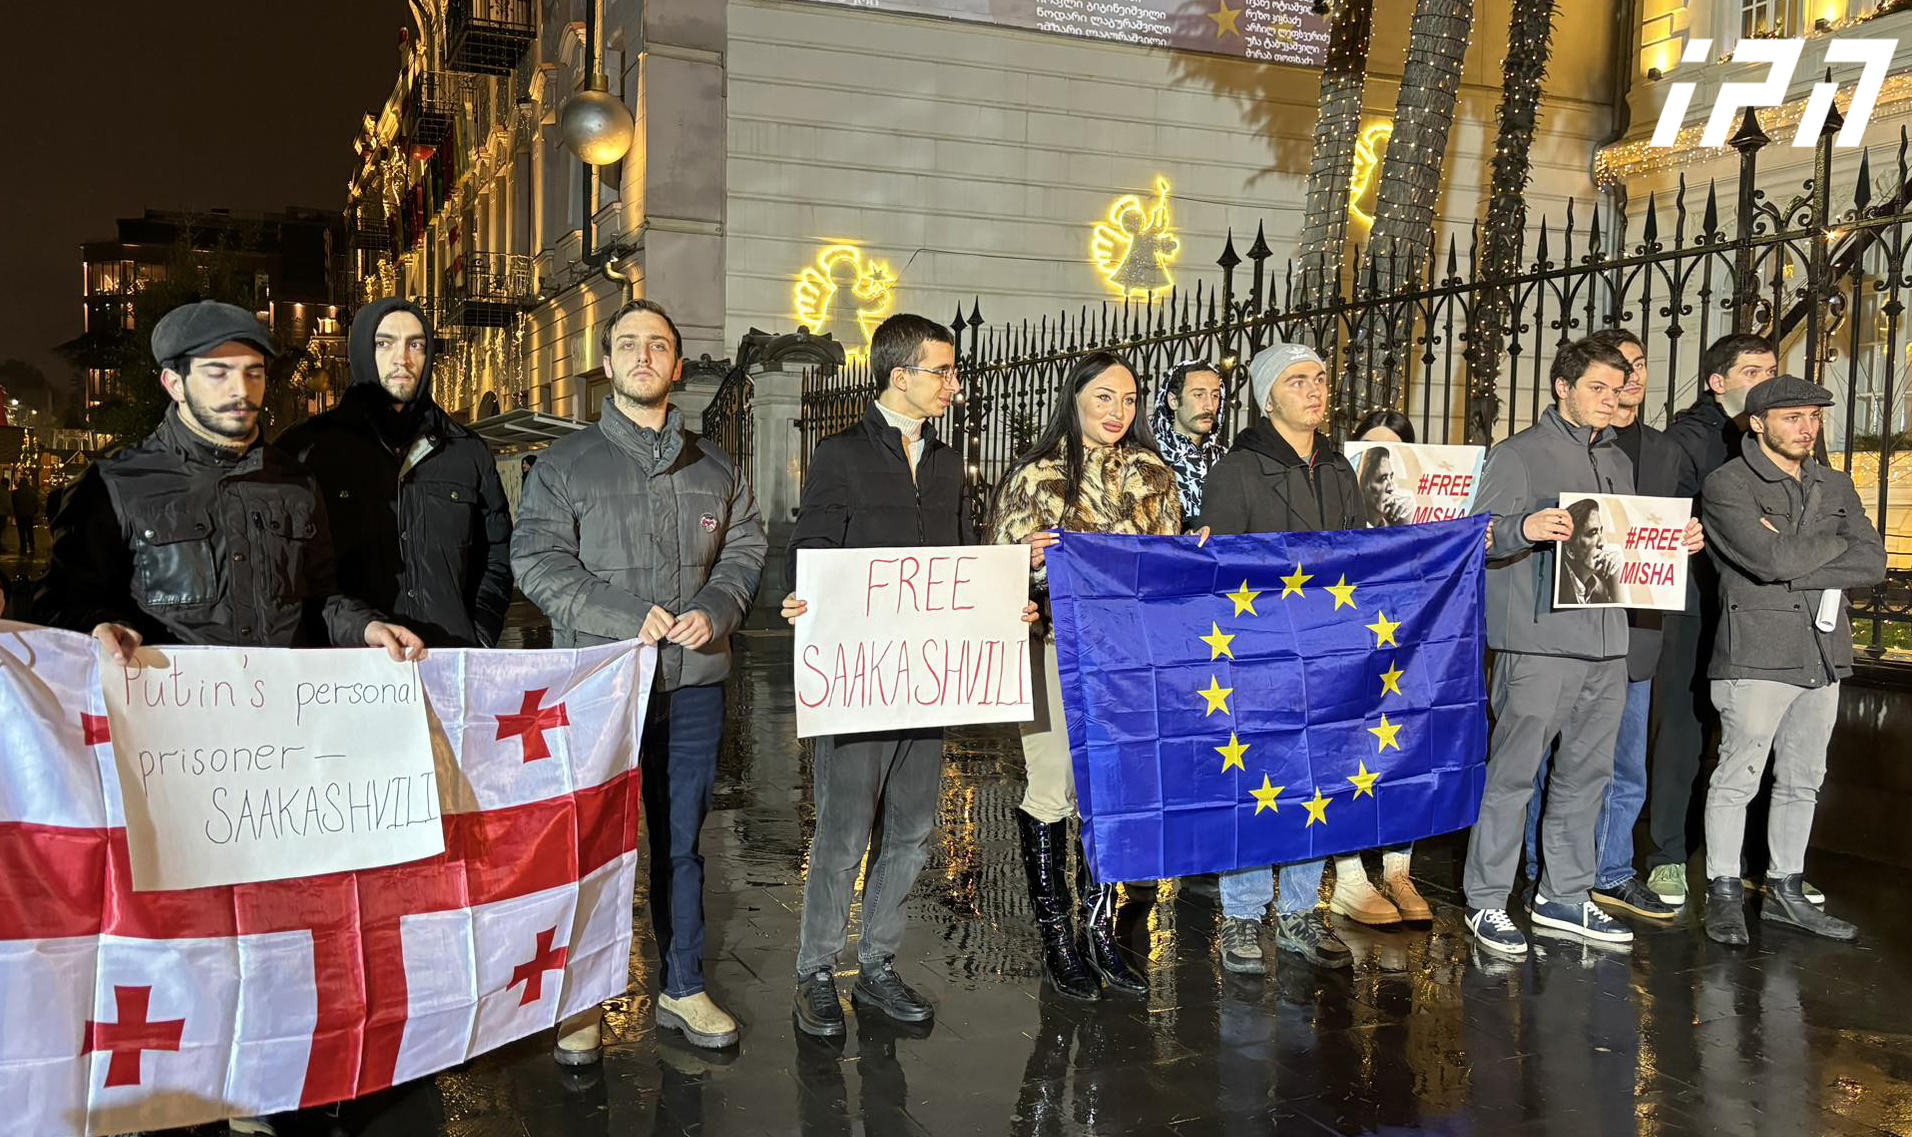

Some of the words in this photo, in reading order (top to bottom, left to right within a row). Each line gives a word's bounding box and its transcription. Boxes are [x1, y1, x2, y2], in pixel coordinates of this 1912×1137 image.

[1036, 6, 1088, 22] ნოდარი
[1417, 473, 1473, 496] #FREE
[1625, 526, 1683, 551] #FREE
[866, 556, 979, 617] FREE
[1619, 562, 1675, 586] MISHA
[124, 655, 265, 708] Putin's
[296, 660, 418, 725] personal
[799, 638, 1032, 708] SAAKASHVILI
[139, 744, 305, 796] prisoner
[205, 771, 439, 845] SAAKASHVILI
